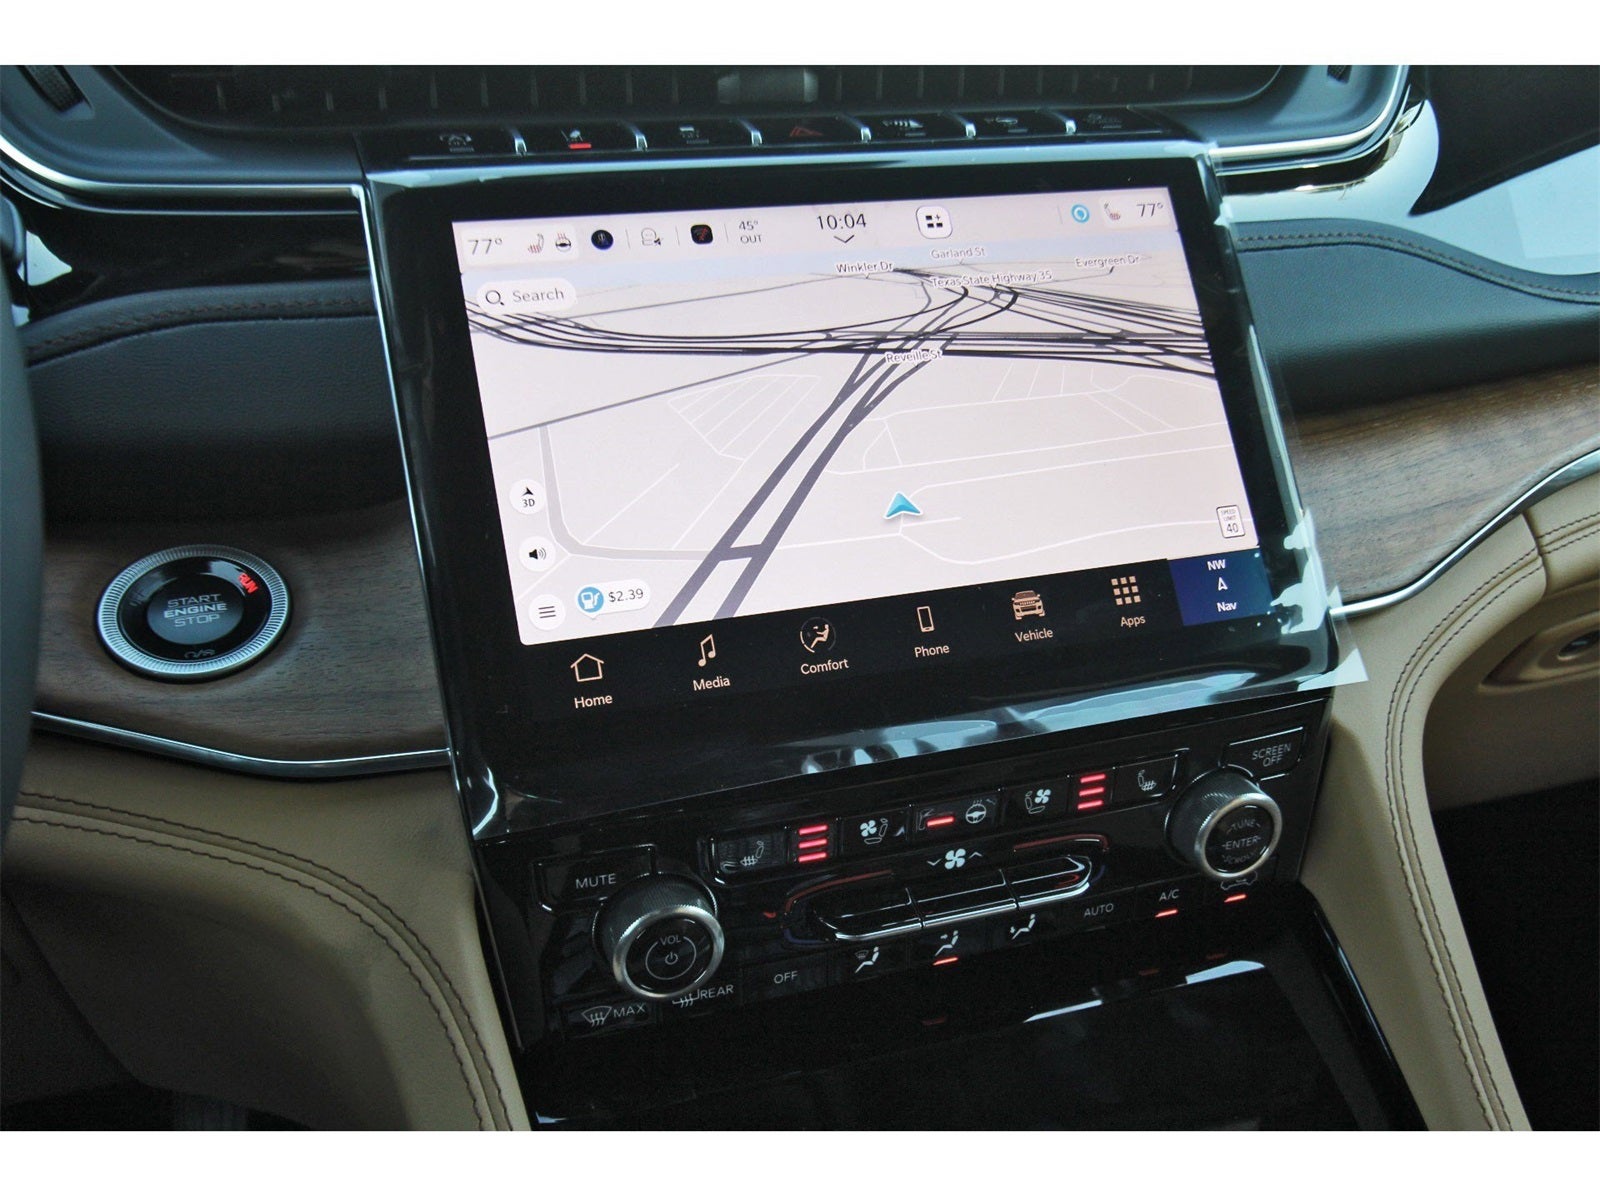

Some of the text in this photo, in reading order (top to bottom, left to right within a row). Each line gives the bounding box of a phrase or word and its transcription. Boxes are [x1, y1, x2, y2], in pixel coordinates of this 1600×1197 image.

[816, 212, 868, 231] 10:04
[740, 234, 762, 245] OUT
[931, 247, 986, 258] Garland St
[836, 262, 893, 273] Winkler Dr
[1075, 256, 1124, 268] Evergreen
[932, 273, 1052, 287] Texas State Highway 35
[512, 288, 565, 303] Search
[886, 350, 942, 363] Reveille St
[522, 498, 536, 508] 3D
[1226, 523, 1239, 533] 40
[1207, 559, 1226, 570] NW
[167, 593, 222, 608] START
[608, 588, 644, 603] $2.39
[164, 602, 227, 618] ENGINE
[1217, 600, 1237, 612] Nav
[174, 613, 220, 627] STOP
[1120, 614, 1145, 628] Apps
[1015, 627, 1053, 643] Vehicle
[914, 643, 950, 658] Phone
[800, 658, 849, 675] Comfort
[693, 675, 731, 692] Media
[574, 694, 613, 709] Home
[1252, 743, 1291, 760] SCREEN
[1262, 754, 1282, 768] OFF
[1225, 835, 1259, 850] ENTER
[575, 872, 617, 889] MUTE
[1158, 888, 1180, 902] A/C
[1083, 903, 1114, 917] AUTO
[659, 935, 681, 946] VOL
[773, 970, 798, 984] OFF
[700, 984, 734, 999] REAR
[613, 1003, 646, 1019] MAX
